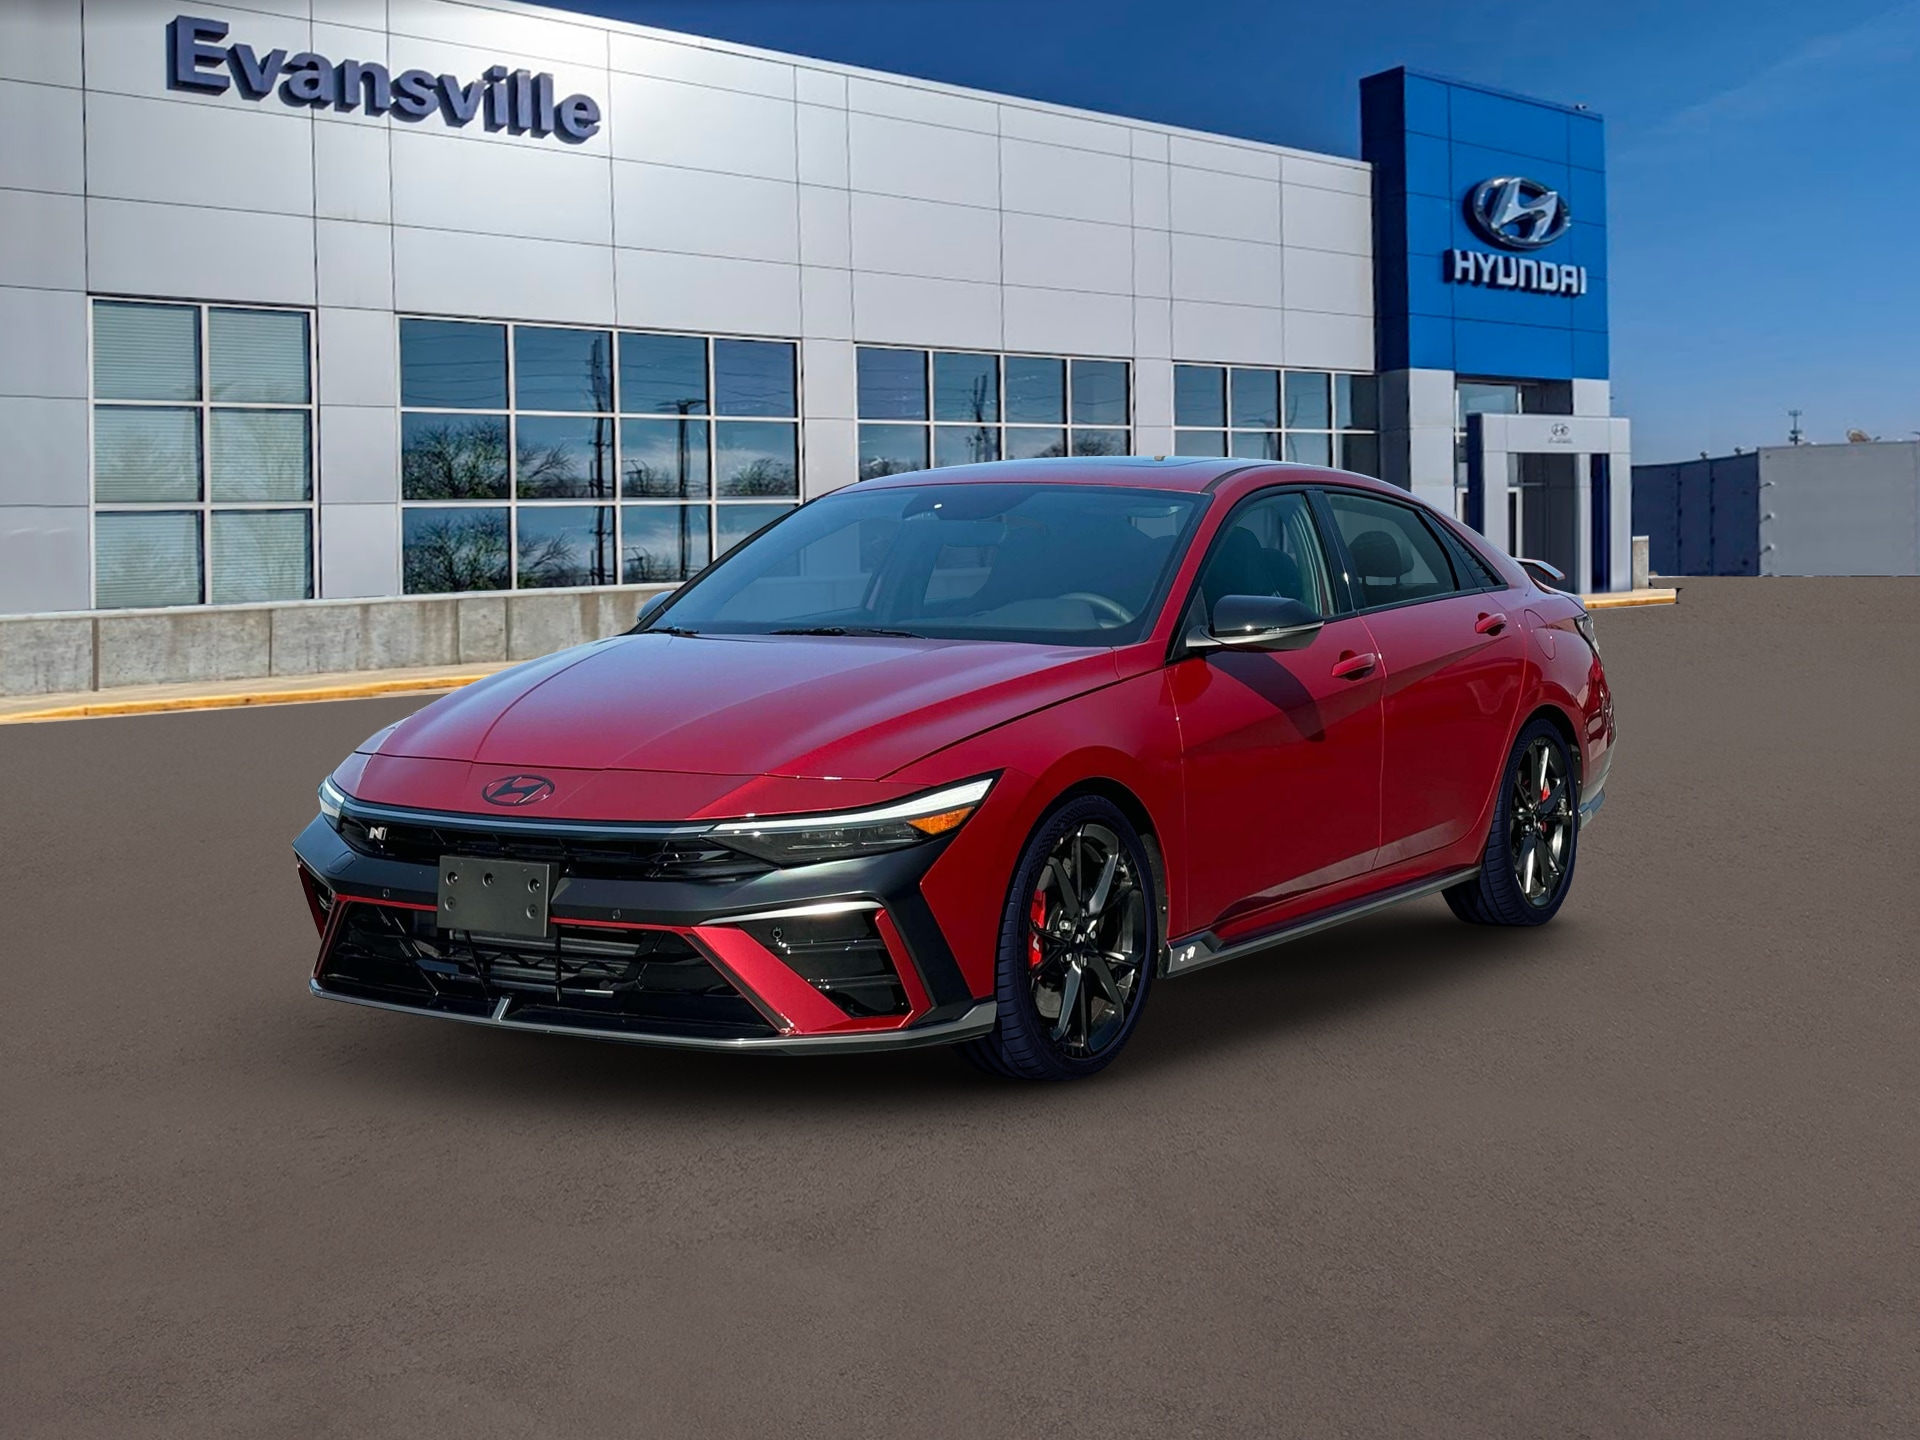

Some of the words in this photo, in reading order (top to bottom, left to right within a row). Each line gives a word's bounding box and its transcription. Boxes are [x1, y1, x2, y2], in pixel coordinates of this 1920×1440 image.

[166, 15, 602, 145] Evansville
[1452, 248, 1588, 295] HYUNDAI
[1075, 933, 1086, 944] N
